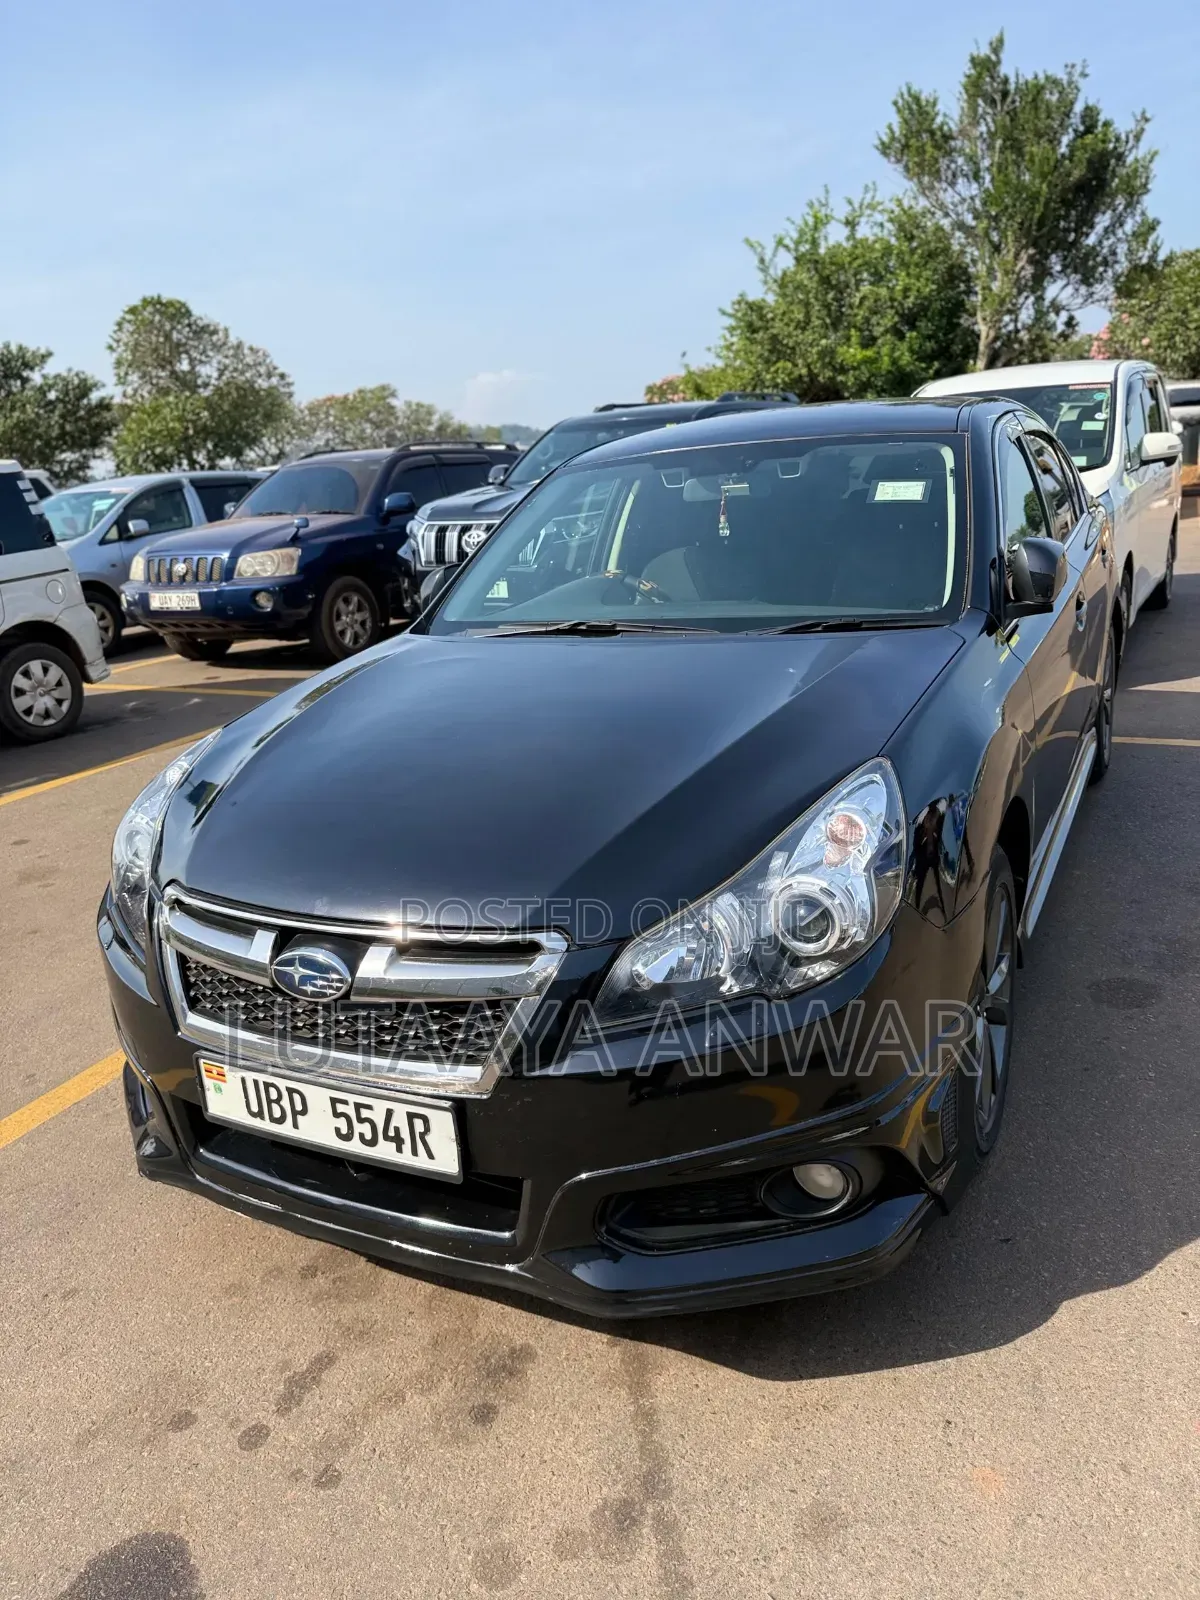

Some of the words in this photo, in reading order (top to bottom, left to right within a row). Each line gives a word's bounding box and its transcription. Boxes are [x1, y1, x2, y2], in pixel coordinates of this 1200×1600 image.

[159, 594, 172, 606] UAY
[240, 1075, 309, 1130] UBP
[329, 1096, 436, 1161] 554R
